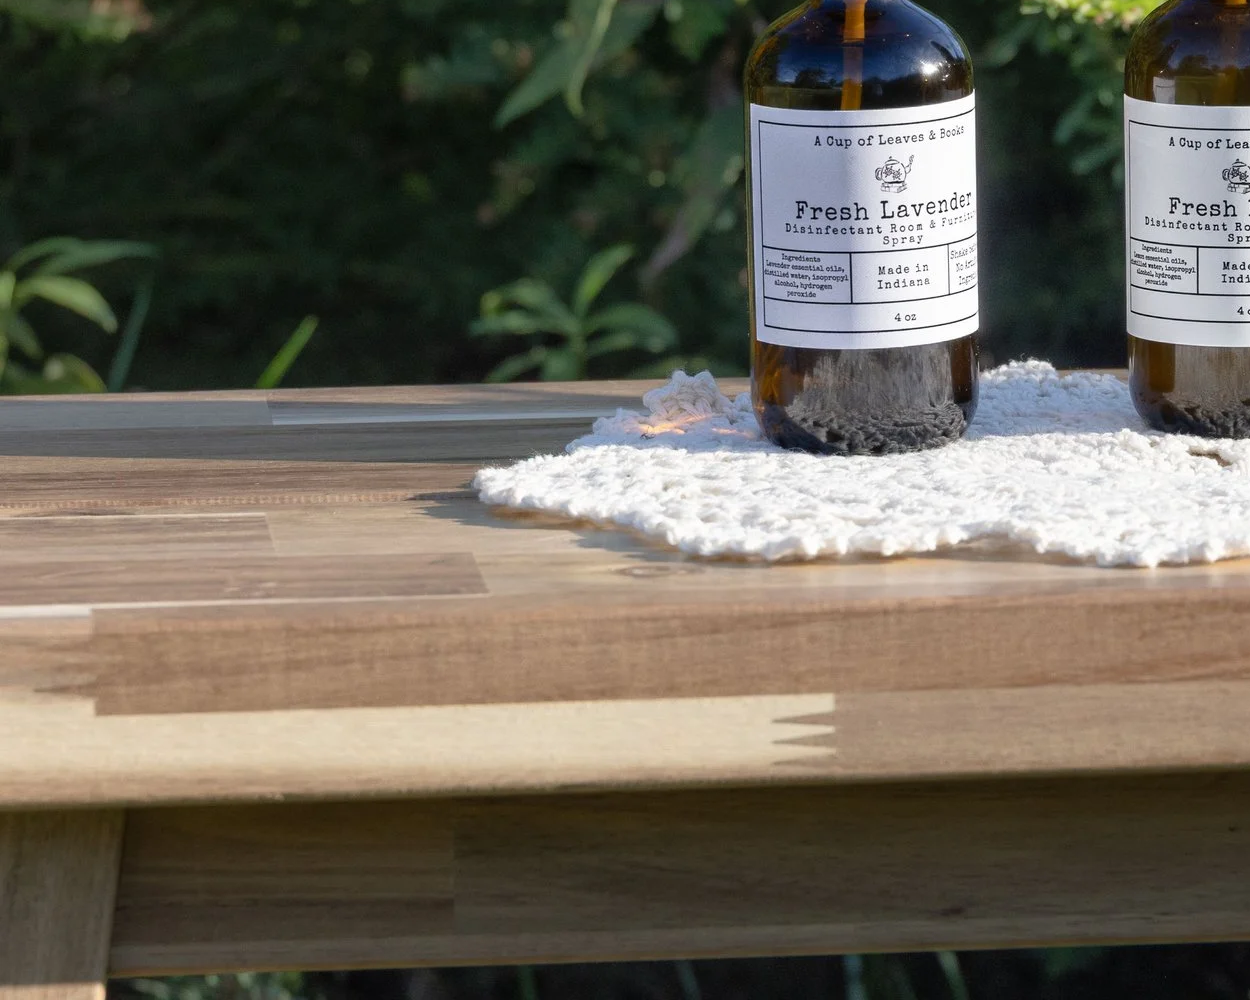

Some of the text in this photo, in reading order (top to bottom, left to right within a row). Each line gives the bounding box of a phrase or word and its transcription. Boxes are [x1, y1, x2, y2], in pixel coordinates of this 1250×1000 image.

[814, 126, 965, 149] A Cup of Leaves & Books
[1169, 137, 1175, 147] A
[1180, 138, 1201, 150] Cup
[1207, 139, 1222, 149] of
[795, 191, 972, 221] Fresh Lavender
[1169, 198, 1238, 217] Fresh
[785, 223, 883, 234] Disinfectant
[890, 223, 923, 233] Room
[1145, 217, 1228, 231] Disinfectant
[883, 234, 924, 247] Spray
[782, 253, 820, 262] Ingredients
[878, 264, 929, 274] Made in
[812, 274, 848, 282] isopropyl
[878, 278, 930, 289] Indiana
[1237, 307, 1244, 315] 4
[895, 313, 901, 321] 4
